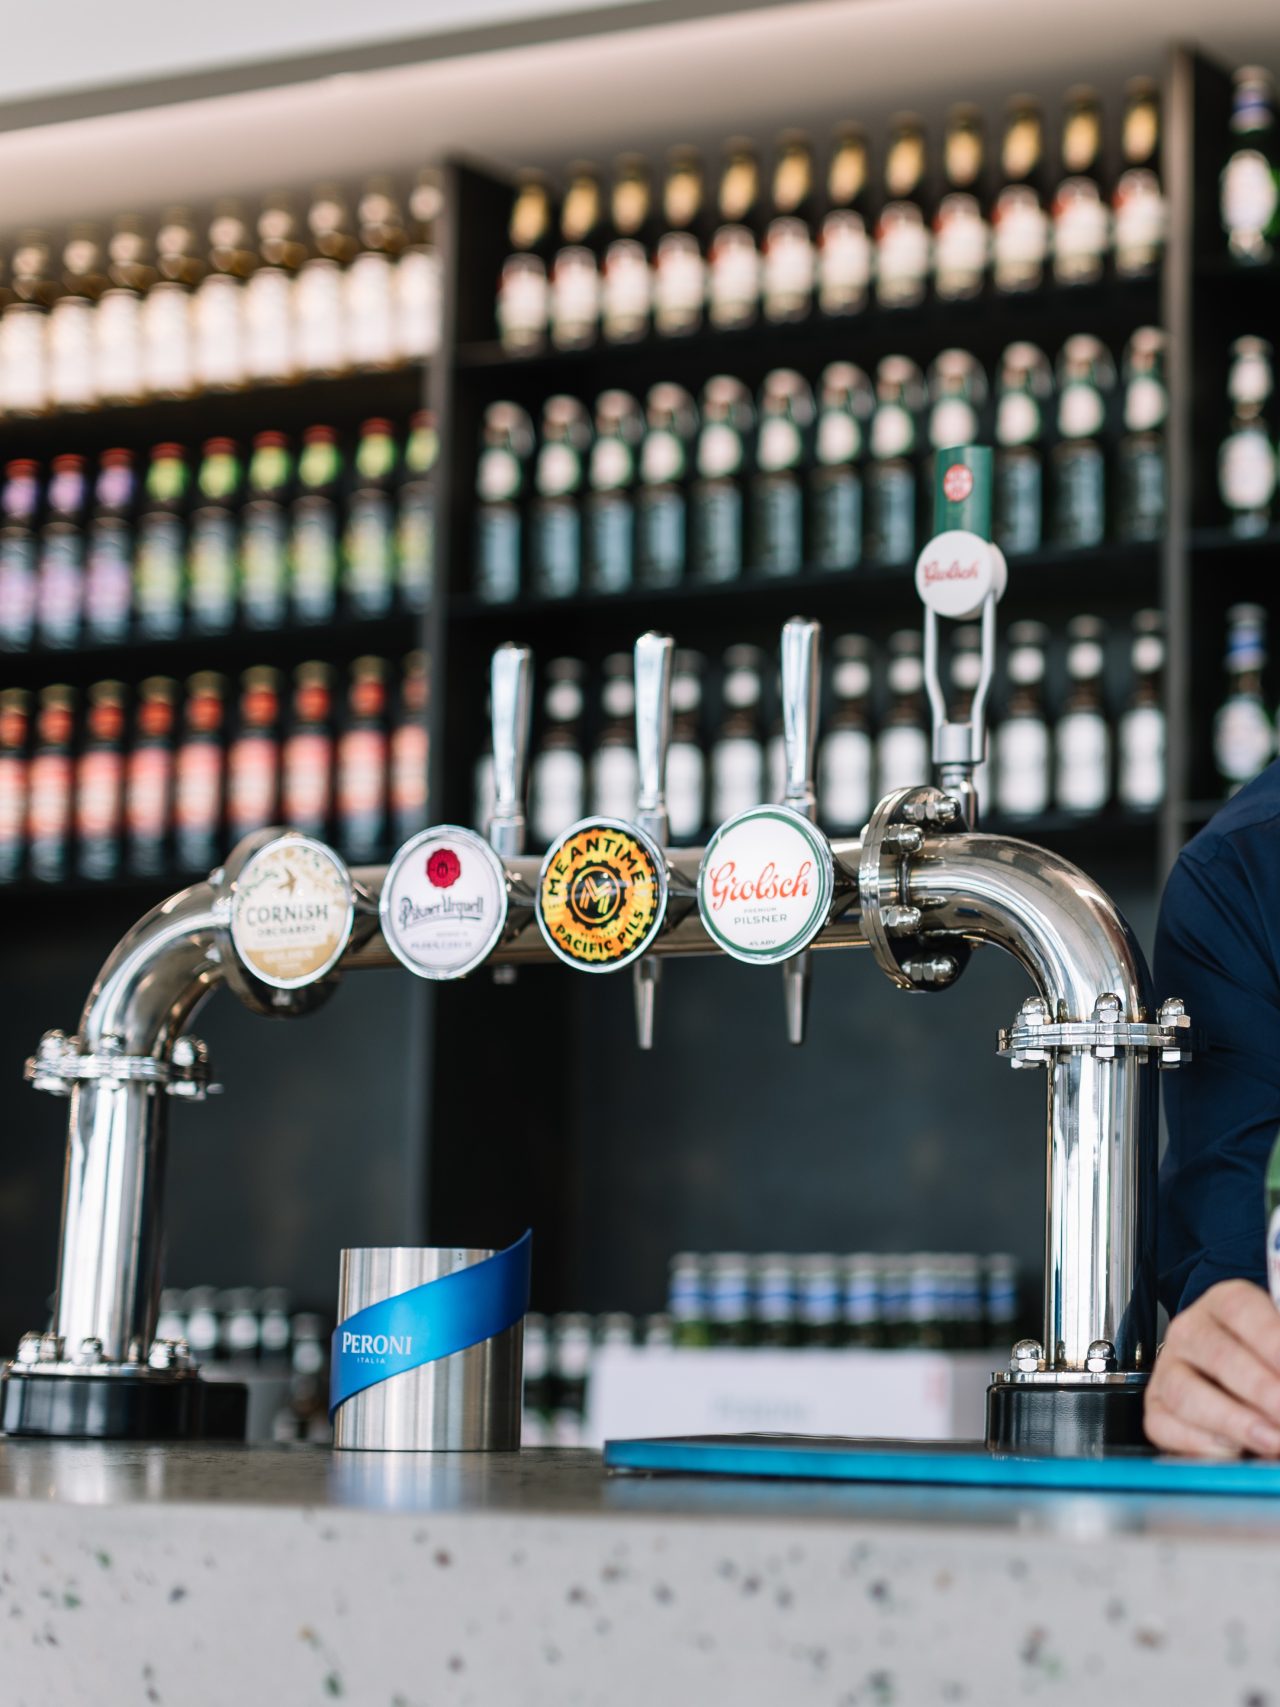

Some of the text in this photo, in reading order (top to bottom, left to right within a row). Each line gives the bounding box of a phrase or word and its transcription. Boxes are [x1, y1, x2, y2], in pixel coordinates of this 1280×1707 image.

[548, 837, 645, 896] MEANTIME
[709, 860, 812, 911] Grolsch
[246, 904, 328, 927] CORNISH
[733, 913, 788, 925] PILSNER
[556, 910, 644, 953] PACIFIC PILS
[342, 1331, 413, 1356] PERONI
[356, 1356, 386, 1365] ITALIA
